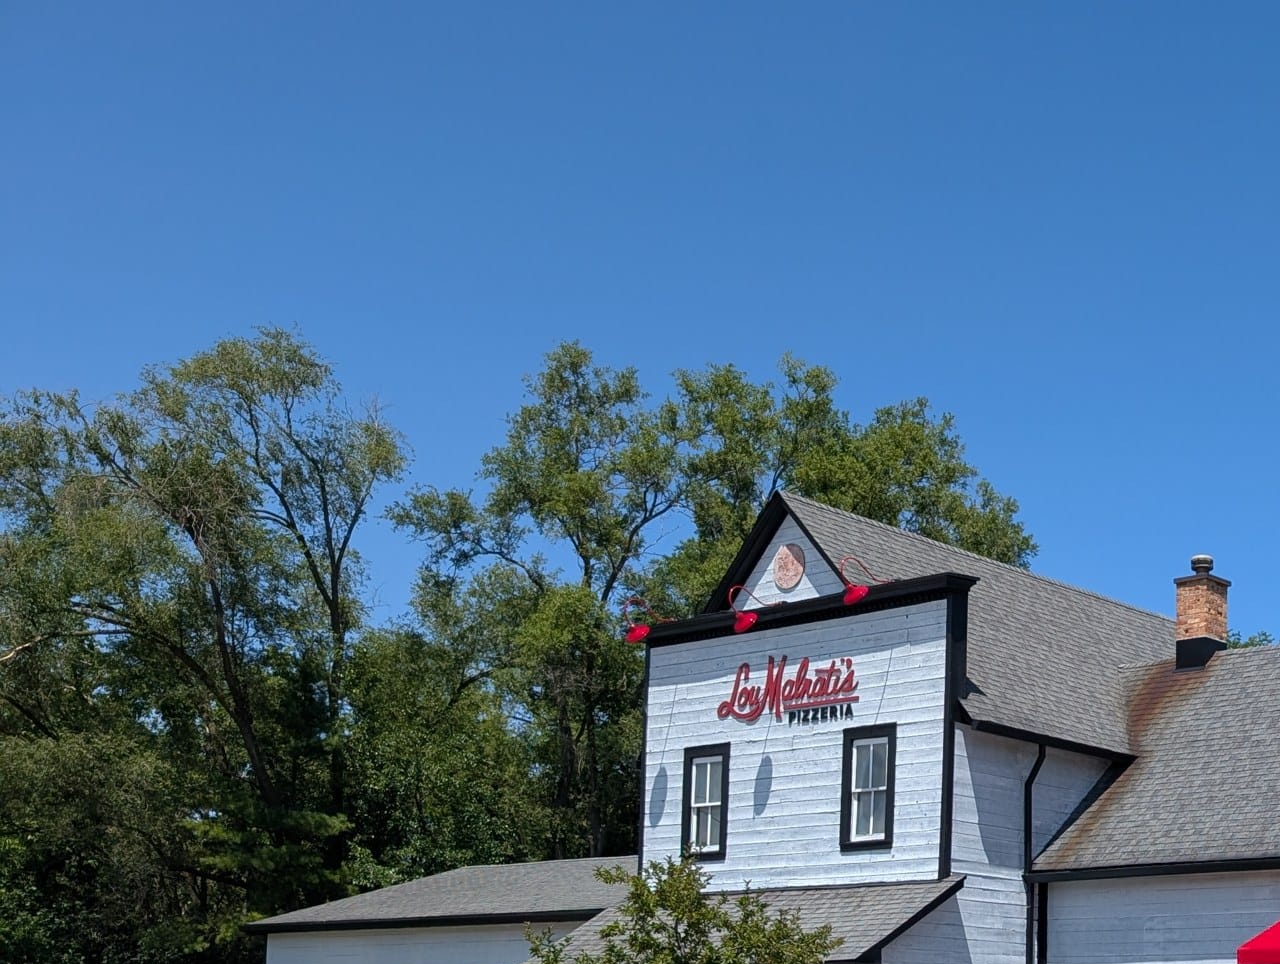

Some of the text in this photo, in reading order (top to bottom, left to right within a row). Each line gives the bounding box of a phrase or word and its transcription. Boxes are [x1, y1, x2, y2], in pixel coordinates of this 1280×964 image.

[717, 654, 859, 724] Lou Malnati's
[788, 703, 854, 727] PIZZERIA
